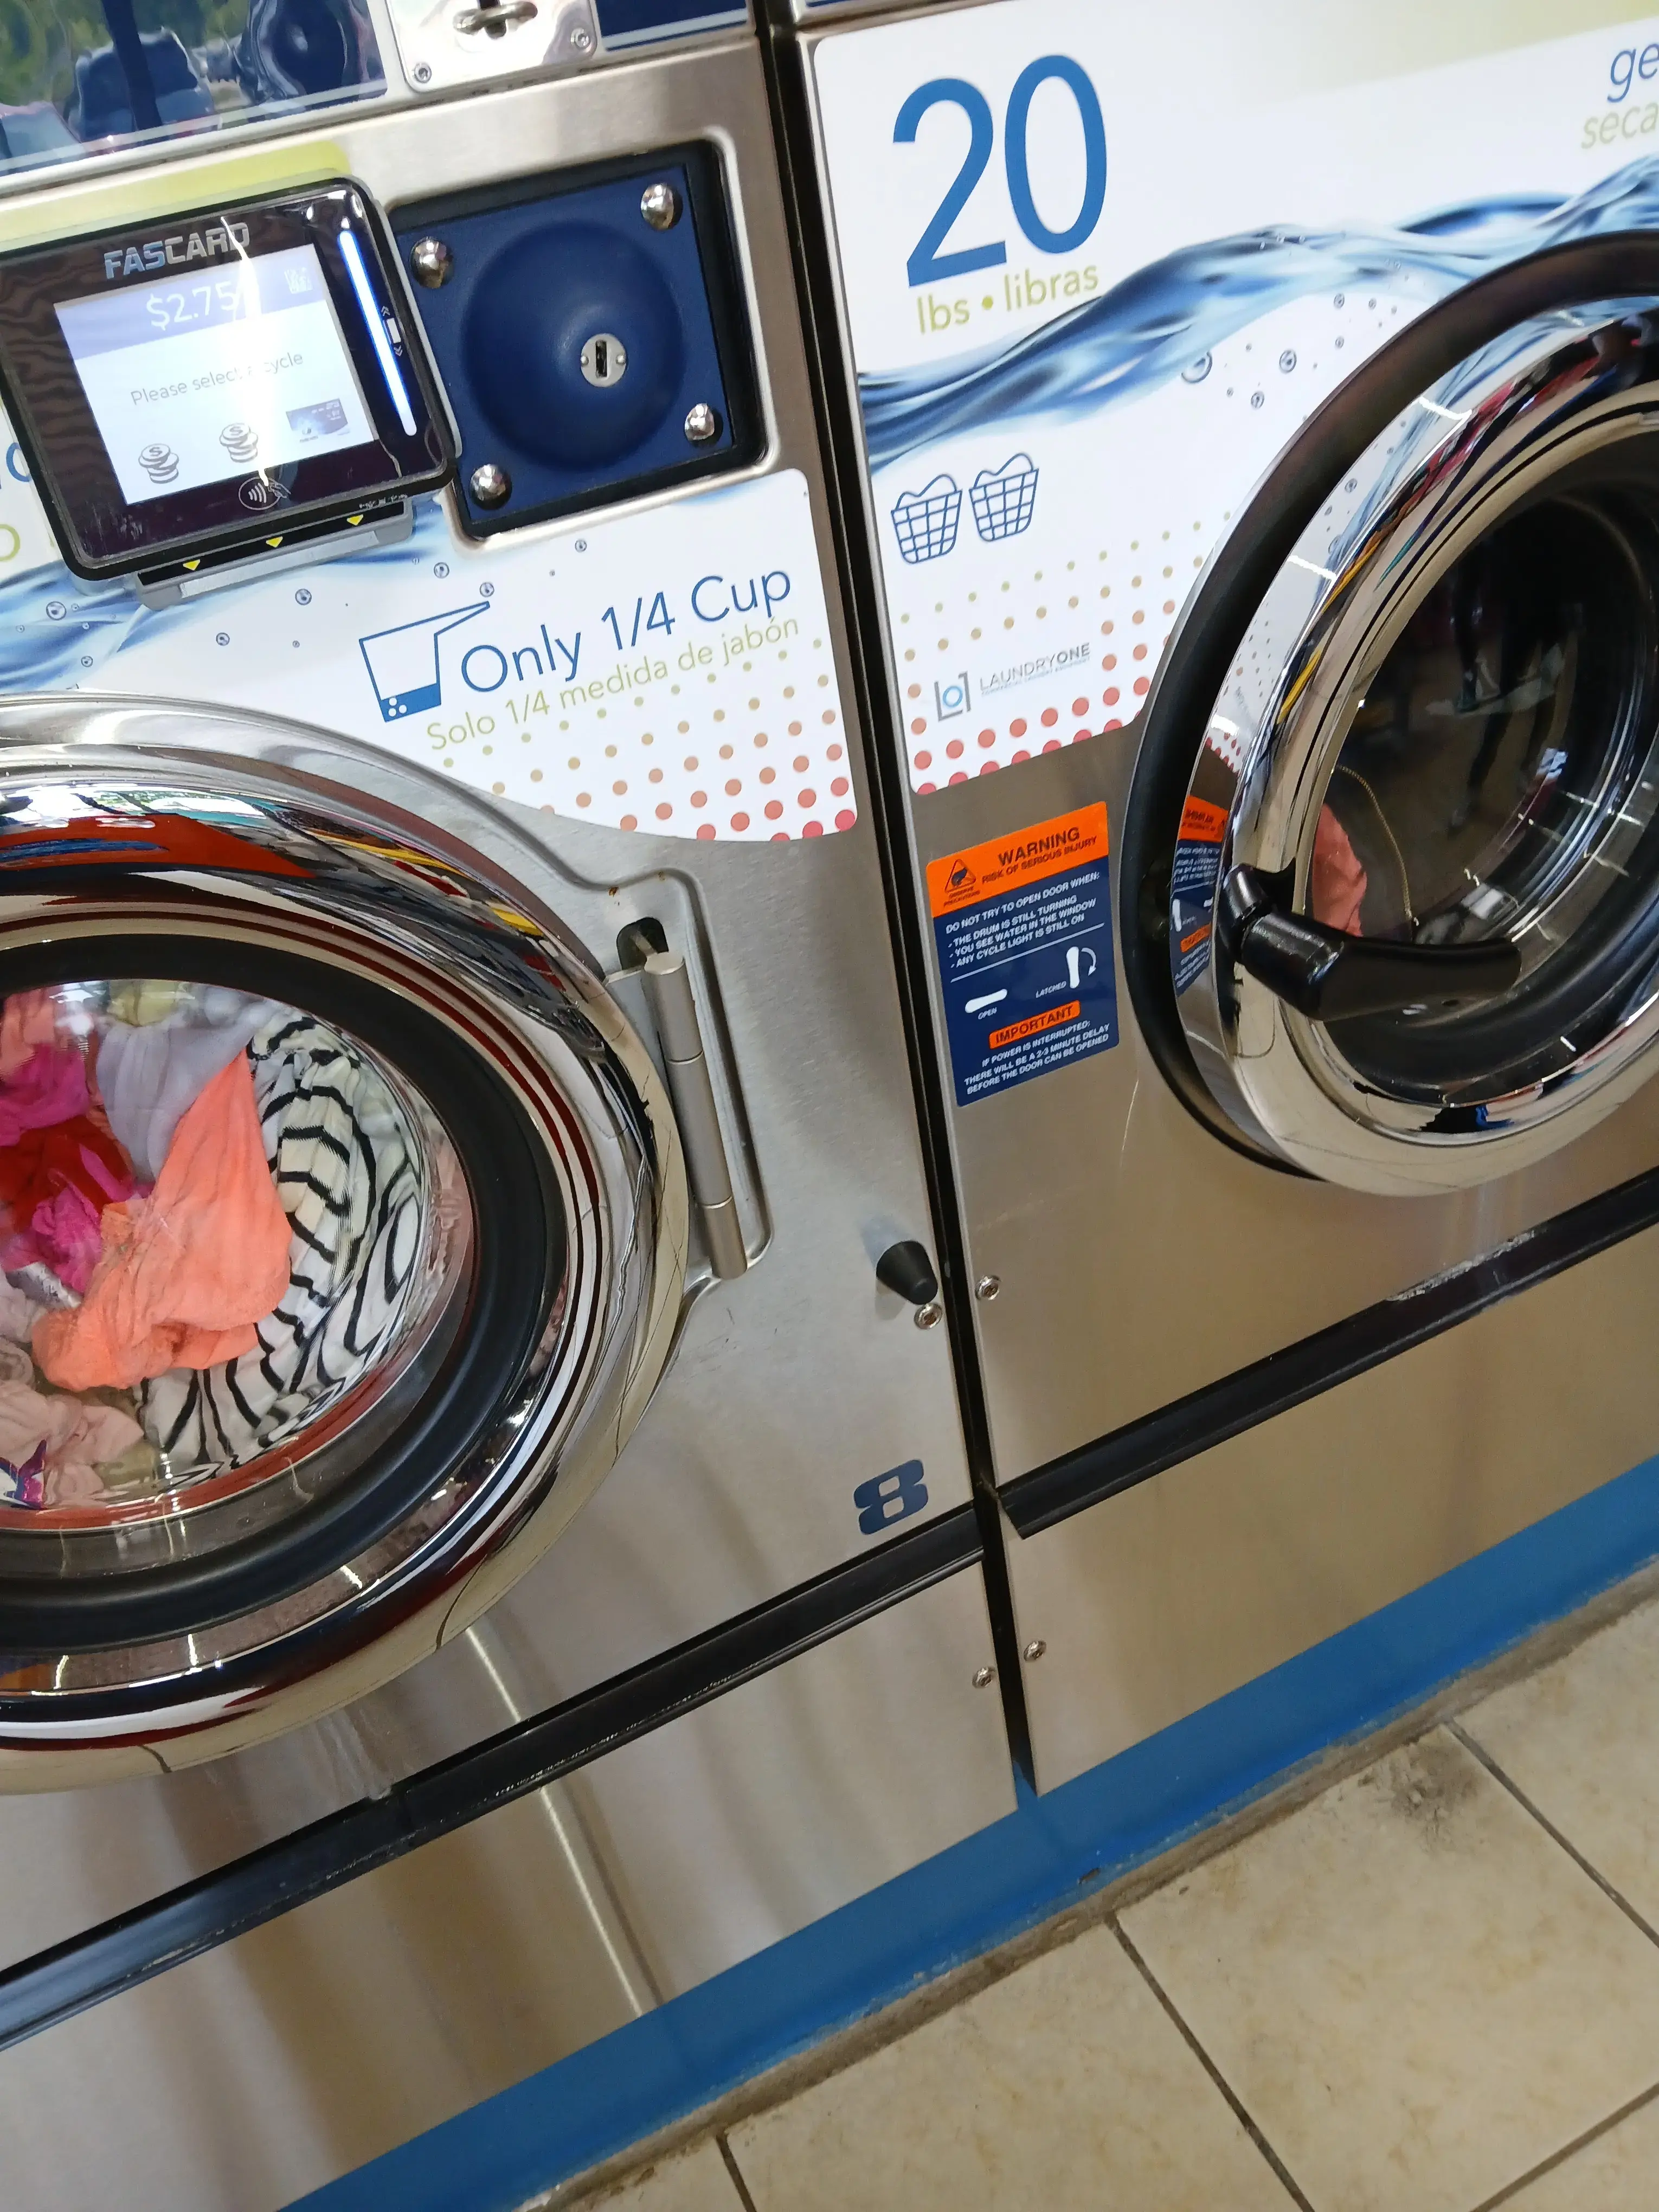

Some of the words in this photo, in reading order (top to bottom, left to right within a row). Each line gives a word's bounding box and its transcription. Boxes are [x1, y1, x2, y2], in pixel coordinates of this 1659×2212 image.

[1580, 102, 1659, 150] seca
[892, 54, 1107, 287] 20
[104, 222, 249, 279] FASCARD
[146, 280, 240, 331] $2.75
[916, 294, 970, 335] lbs
[1004, 264, 1099, 312] libras
[131, 382, 188, 406] Please
[461, 623, 581, 692] Only
[601, 591, 676, 650] 1/4
[691, 570, 791, 622] Cup
[427, 712, 496, 750] Solo
[505, 689, 550, 724] 1/4
[559, 664, 669, 709] medida
[677, 642, 713, 672] de
[720, 616, 799, 666] jabón
[980, 641, 1090, 691] LAUNDRYONE
[982, 870, 1005, 885] RISK
[1006, 864, 1019, 877] OF
[1021, 851, 1062, 870] SERIOUS
[1063, 836, 1097, 855] INJURY
[998, 826, 1081, 867] WARNING
[946, 922, 960, 934] DO
[962, 914, 981, 928] NOT
[982, 906, 1000, 921] TRY
[1001, 902, 1014, 913] TO
[1016, 892, 1041, 908] OPEN
[1043, 882, 1069, 898] DOOR
[953, 933, 972, 947] THE
[973, 923, 1000, 940] DRUM
[1001, 918, 1011, 928] IS
[1011, 910, 1037, 927] STILL
[1037, 895, 1077, 916] TURNING
[955, 943, 974, 957] YOU
[976, 936, 994, 950] SEE
[995, 923, 1027, 942] WATER
[1028, 919, 1038, 930] IN
[1039, 912, 1057, 926] THE
[1058, 898, 1096, 919] WINDOW
[956, 954, 975, 968] ANY
[976, 942, 1006, 960] CYCLE
[1007, 932, 1033, 949] LIGHT
[1035, 928, 1044, 938] IS
[1045, 919, 1070, 935] STILL
[1071, 913, 1085, 925] ON
[978, 1007, 998, 1020] OPEN
[1036, 981, 1067, 999] LATCHED
[995, 1005, 1074, 1044] IMPORTANT
[964, 1068, 993, 1085] THERE
[994, 1060, 1014, 1073] WILL
[1015, 1055, 1027, 1066] BE
[1028, 1052, 1036, 1061] A
[1050, 1035, 1081, 1053] MINUTE
[1082, 1023, 1110, 1041] DELAY
[967, 1076, 1000, 1095] BEFORE
[1001, 1069, 1018, 1081] THE
[1019, 1059, 1044, 1074] DOOR
[1044, 1053, 1062, 1064] CAN
[1063, 1046, 1075, 1058] BE
[1076, 1033, 1109, 1052] OPENED
[991, 1046, 1022, 1064] POWER
[1023, 1042, 1031, 1051] IS
[853, 1459, 929, 1535] 8
